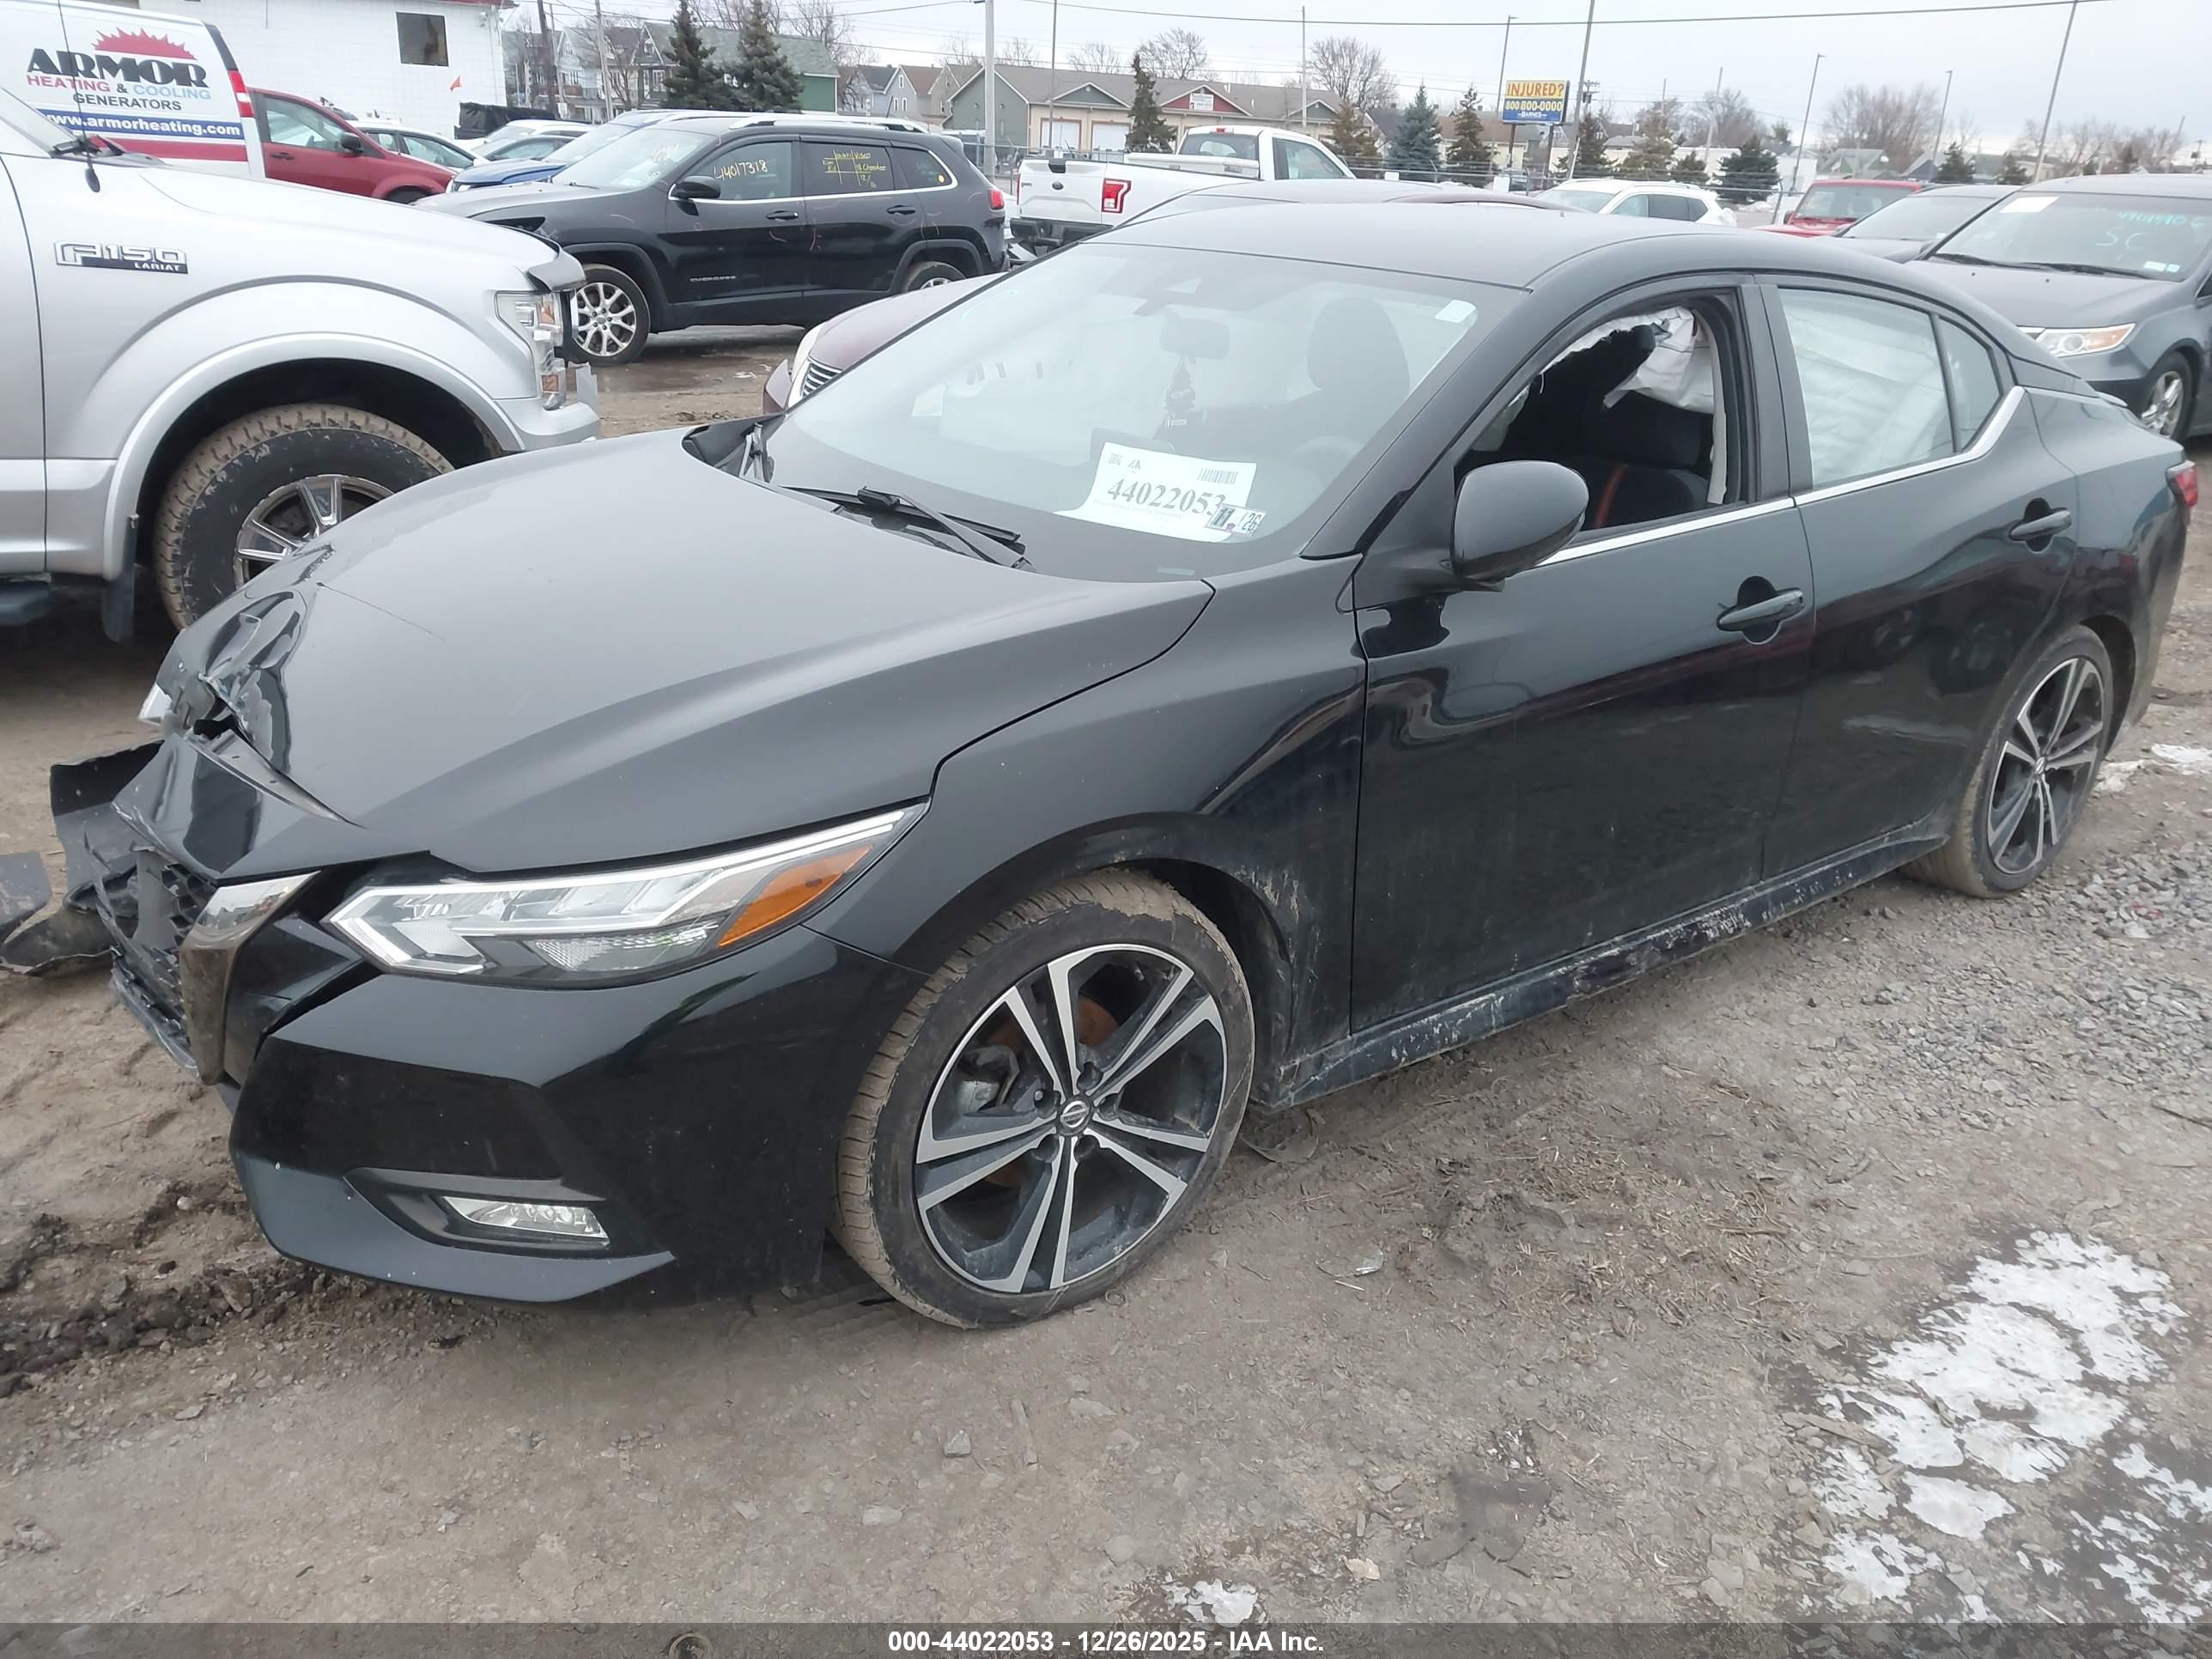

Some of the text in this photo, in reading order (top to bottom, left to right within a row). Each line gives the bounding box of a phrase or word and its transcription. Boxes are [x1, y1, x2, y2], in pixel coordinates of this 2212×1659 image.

[27, 47, 209, 88] ARMOR
[27, 75, 211, 100] HEATING & COOLING
[1507, 82, 1564, 96] INJURED?
[72, 93, 182, 111] GENERATORS
[1521, 101, 1562, 111] 800-0000
[46, 113, 240, 137] ww.armorheating.com
[714, 159, 768, 181] 44017318
[135, 262, 180, 272] LARIAT
